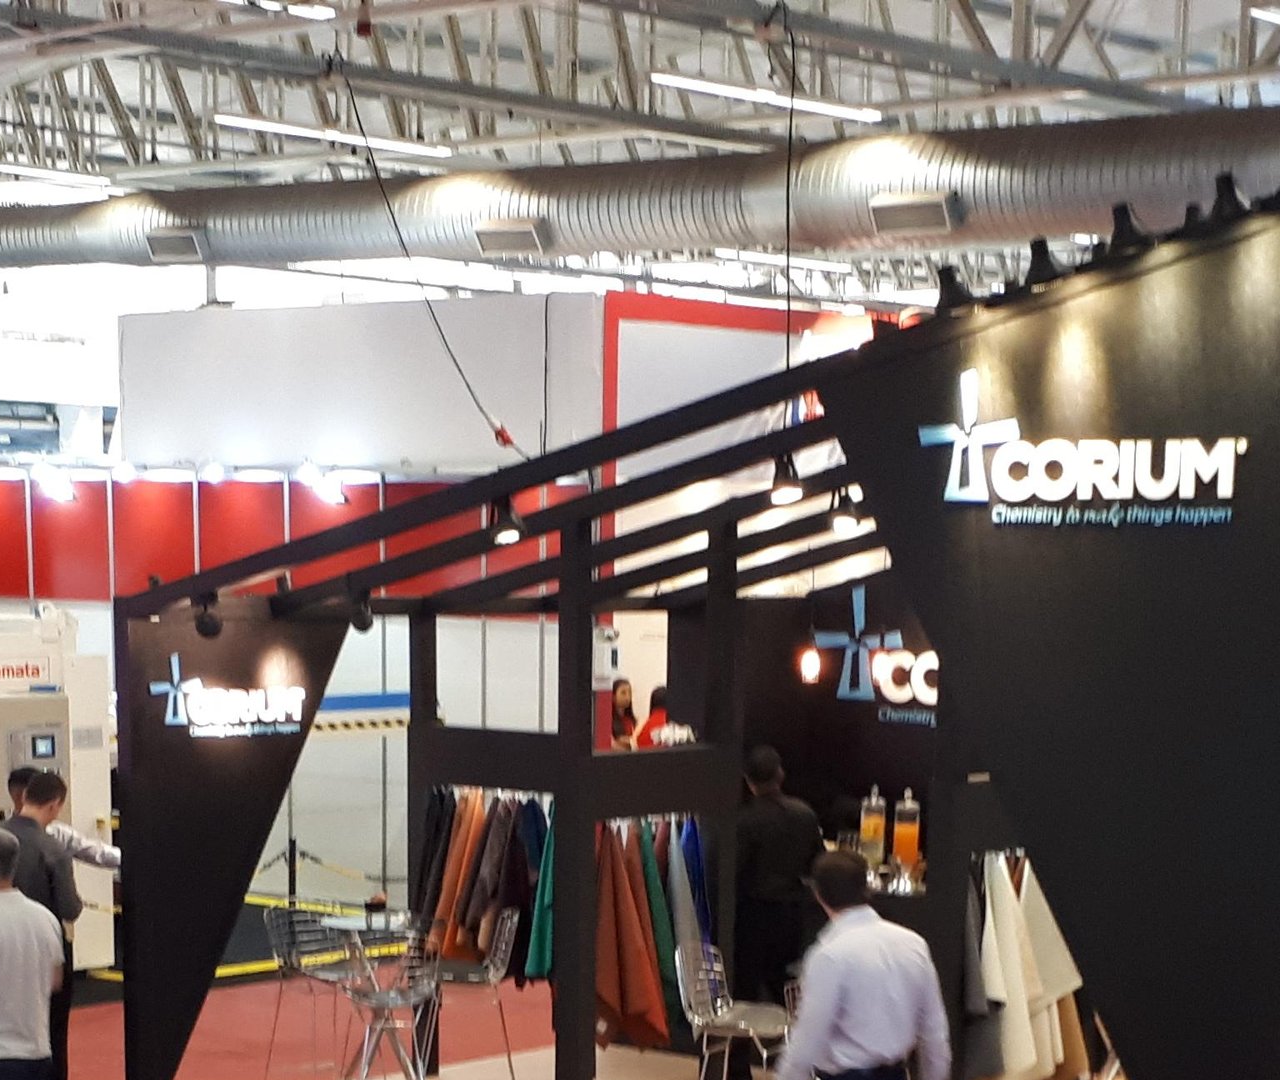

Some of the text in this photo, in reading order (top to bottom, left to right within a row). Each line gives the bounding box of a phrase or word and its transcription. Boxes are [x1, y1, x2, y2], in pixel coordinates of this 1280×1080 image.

[991, 437, 1235, 502] CORIUM
[991, 503, 1063, 527] Chemistry
[1126, 504, 1170, 527] things
[1174, 504, 1233, 527] happen
